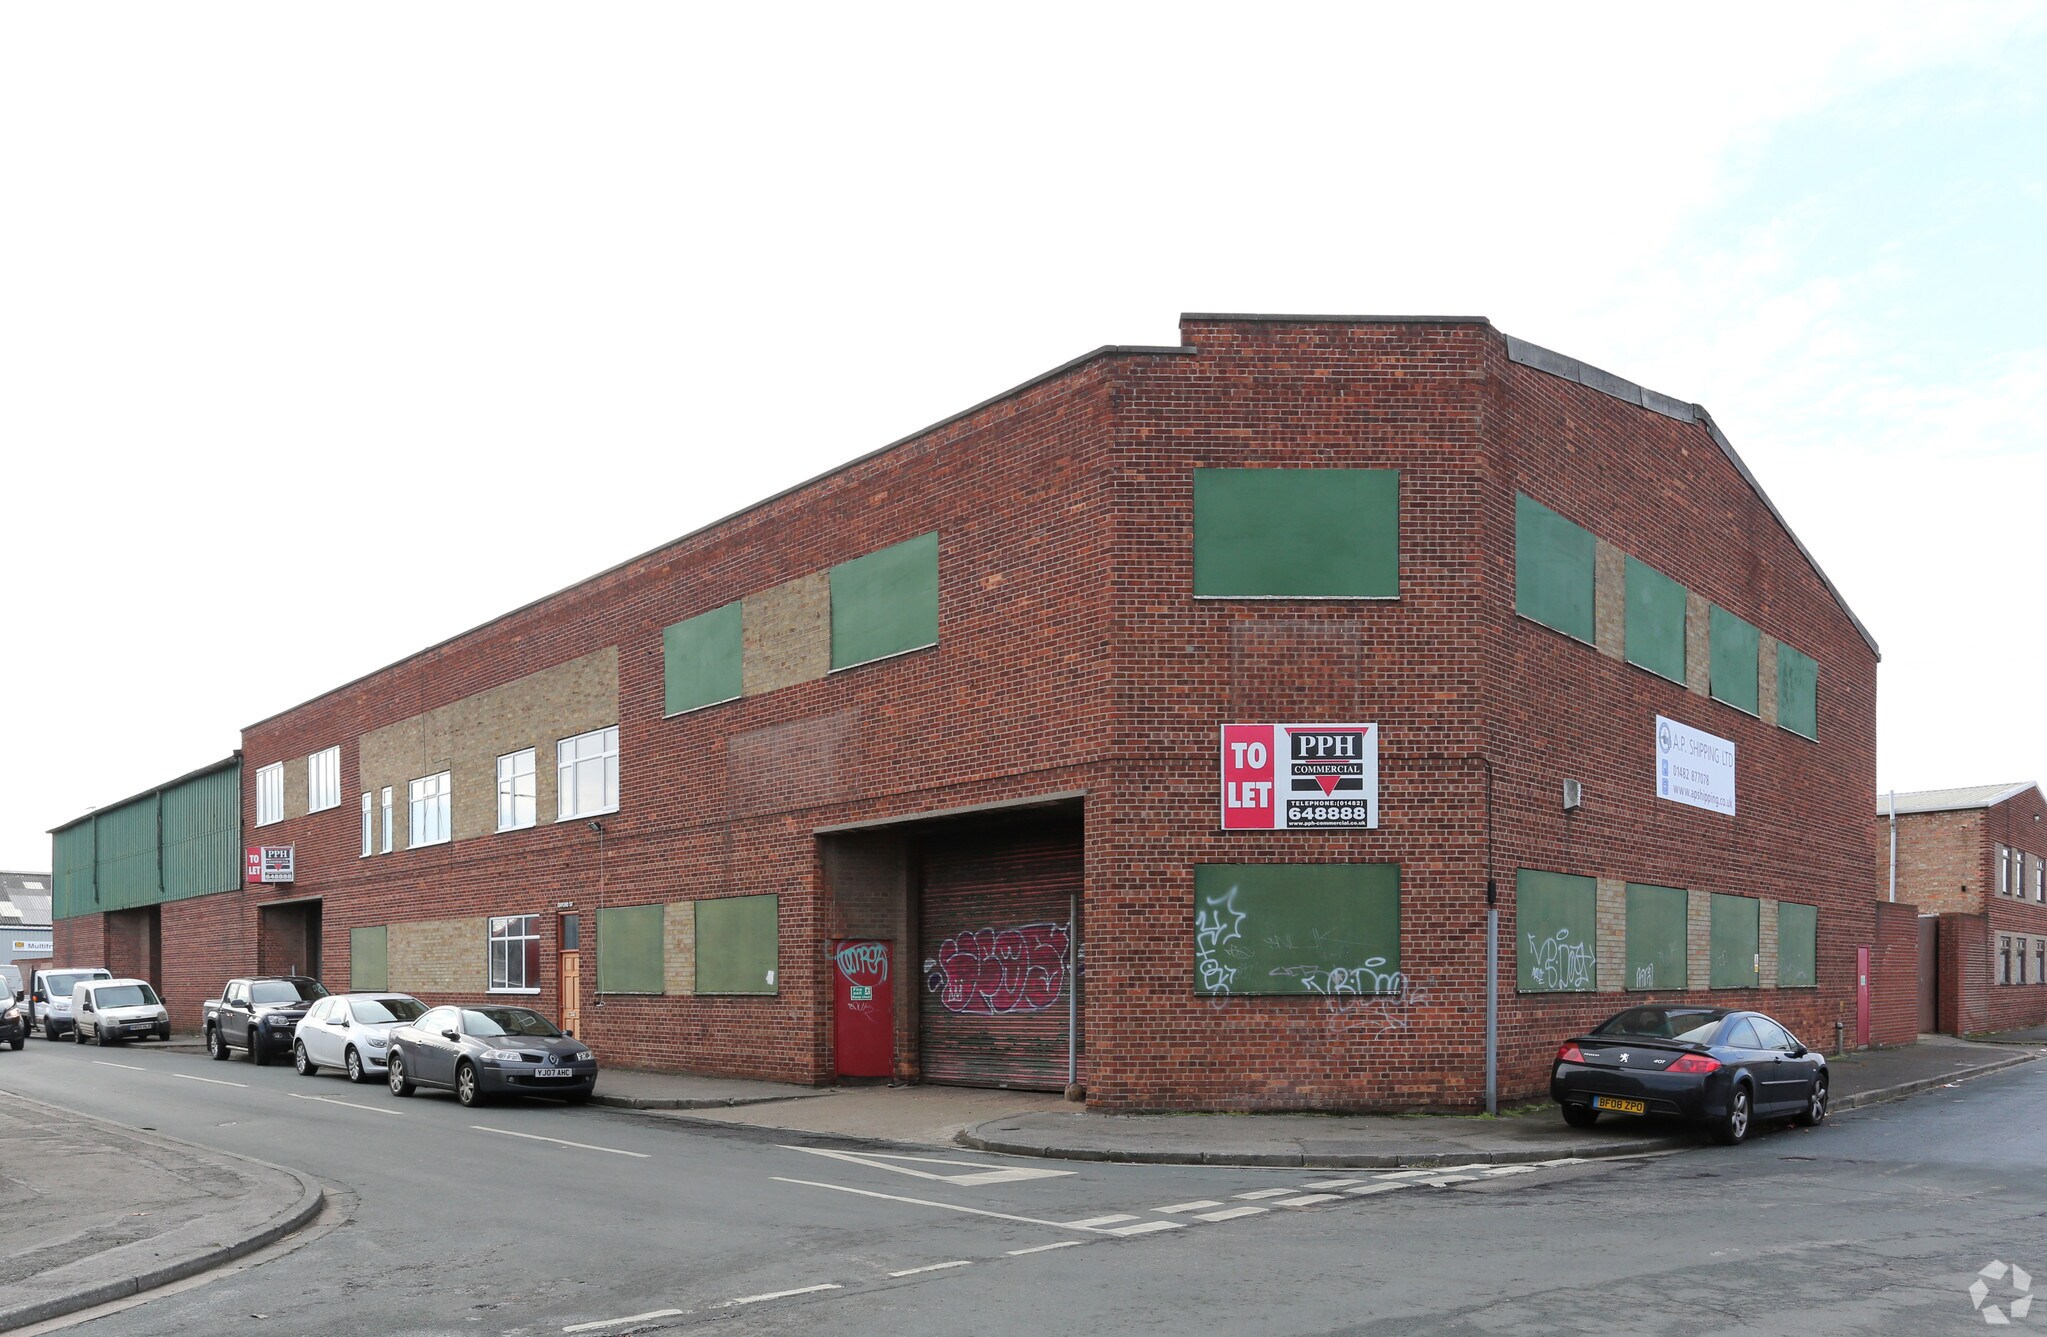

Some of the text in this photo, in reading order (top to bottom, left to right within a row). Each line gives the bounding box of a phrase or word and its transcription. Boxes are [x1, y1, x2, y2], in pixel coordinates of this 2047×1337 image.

[1298, 735, 1355, 757] PPH
[1672, 734, 1733, 767] A.P. SHIPPING LTD
[1231, 742, 1267, 769] TO
[1294, 765, 1360, 773] COMMERCIAL
[1673, 765, 1709, 785] 01482 877078
[1227, 781, 1272, 808] LET
[1673, 784, 1733, 808] www.apshipping.co.uk
[1288, 807, 1366, 820] 648888
[249, 854, 259, 864] TO
[268, 850, 287, 858] PPH
[248, 866, 260, 875] LET
[1600, 1098, 1643, 1111] BF08 ZPO
